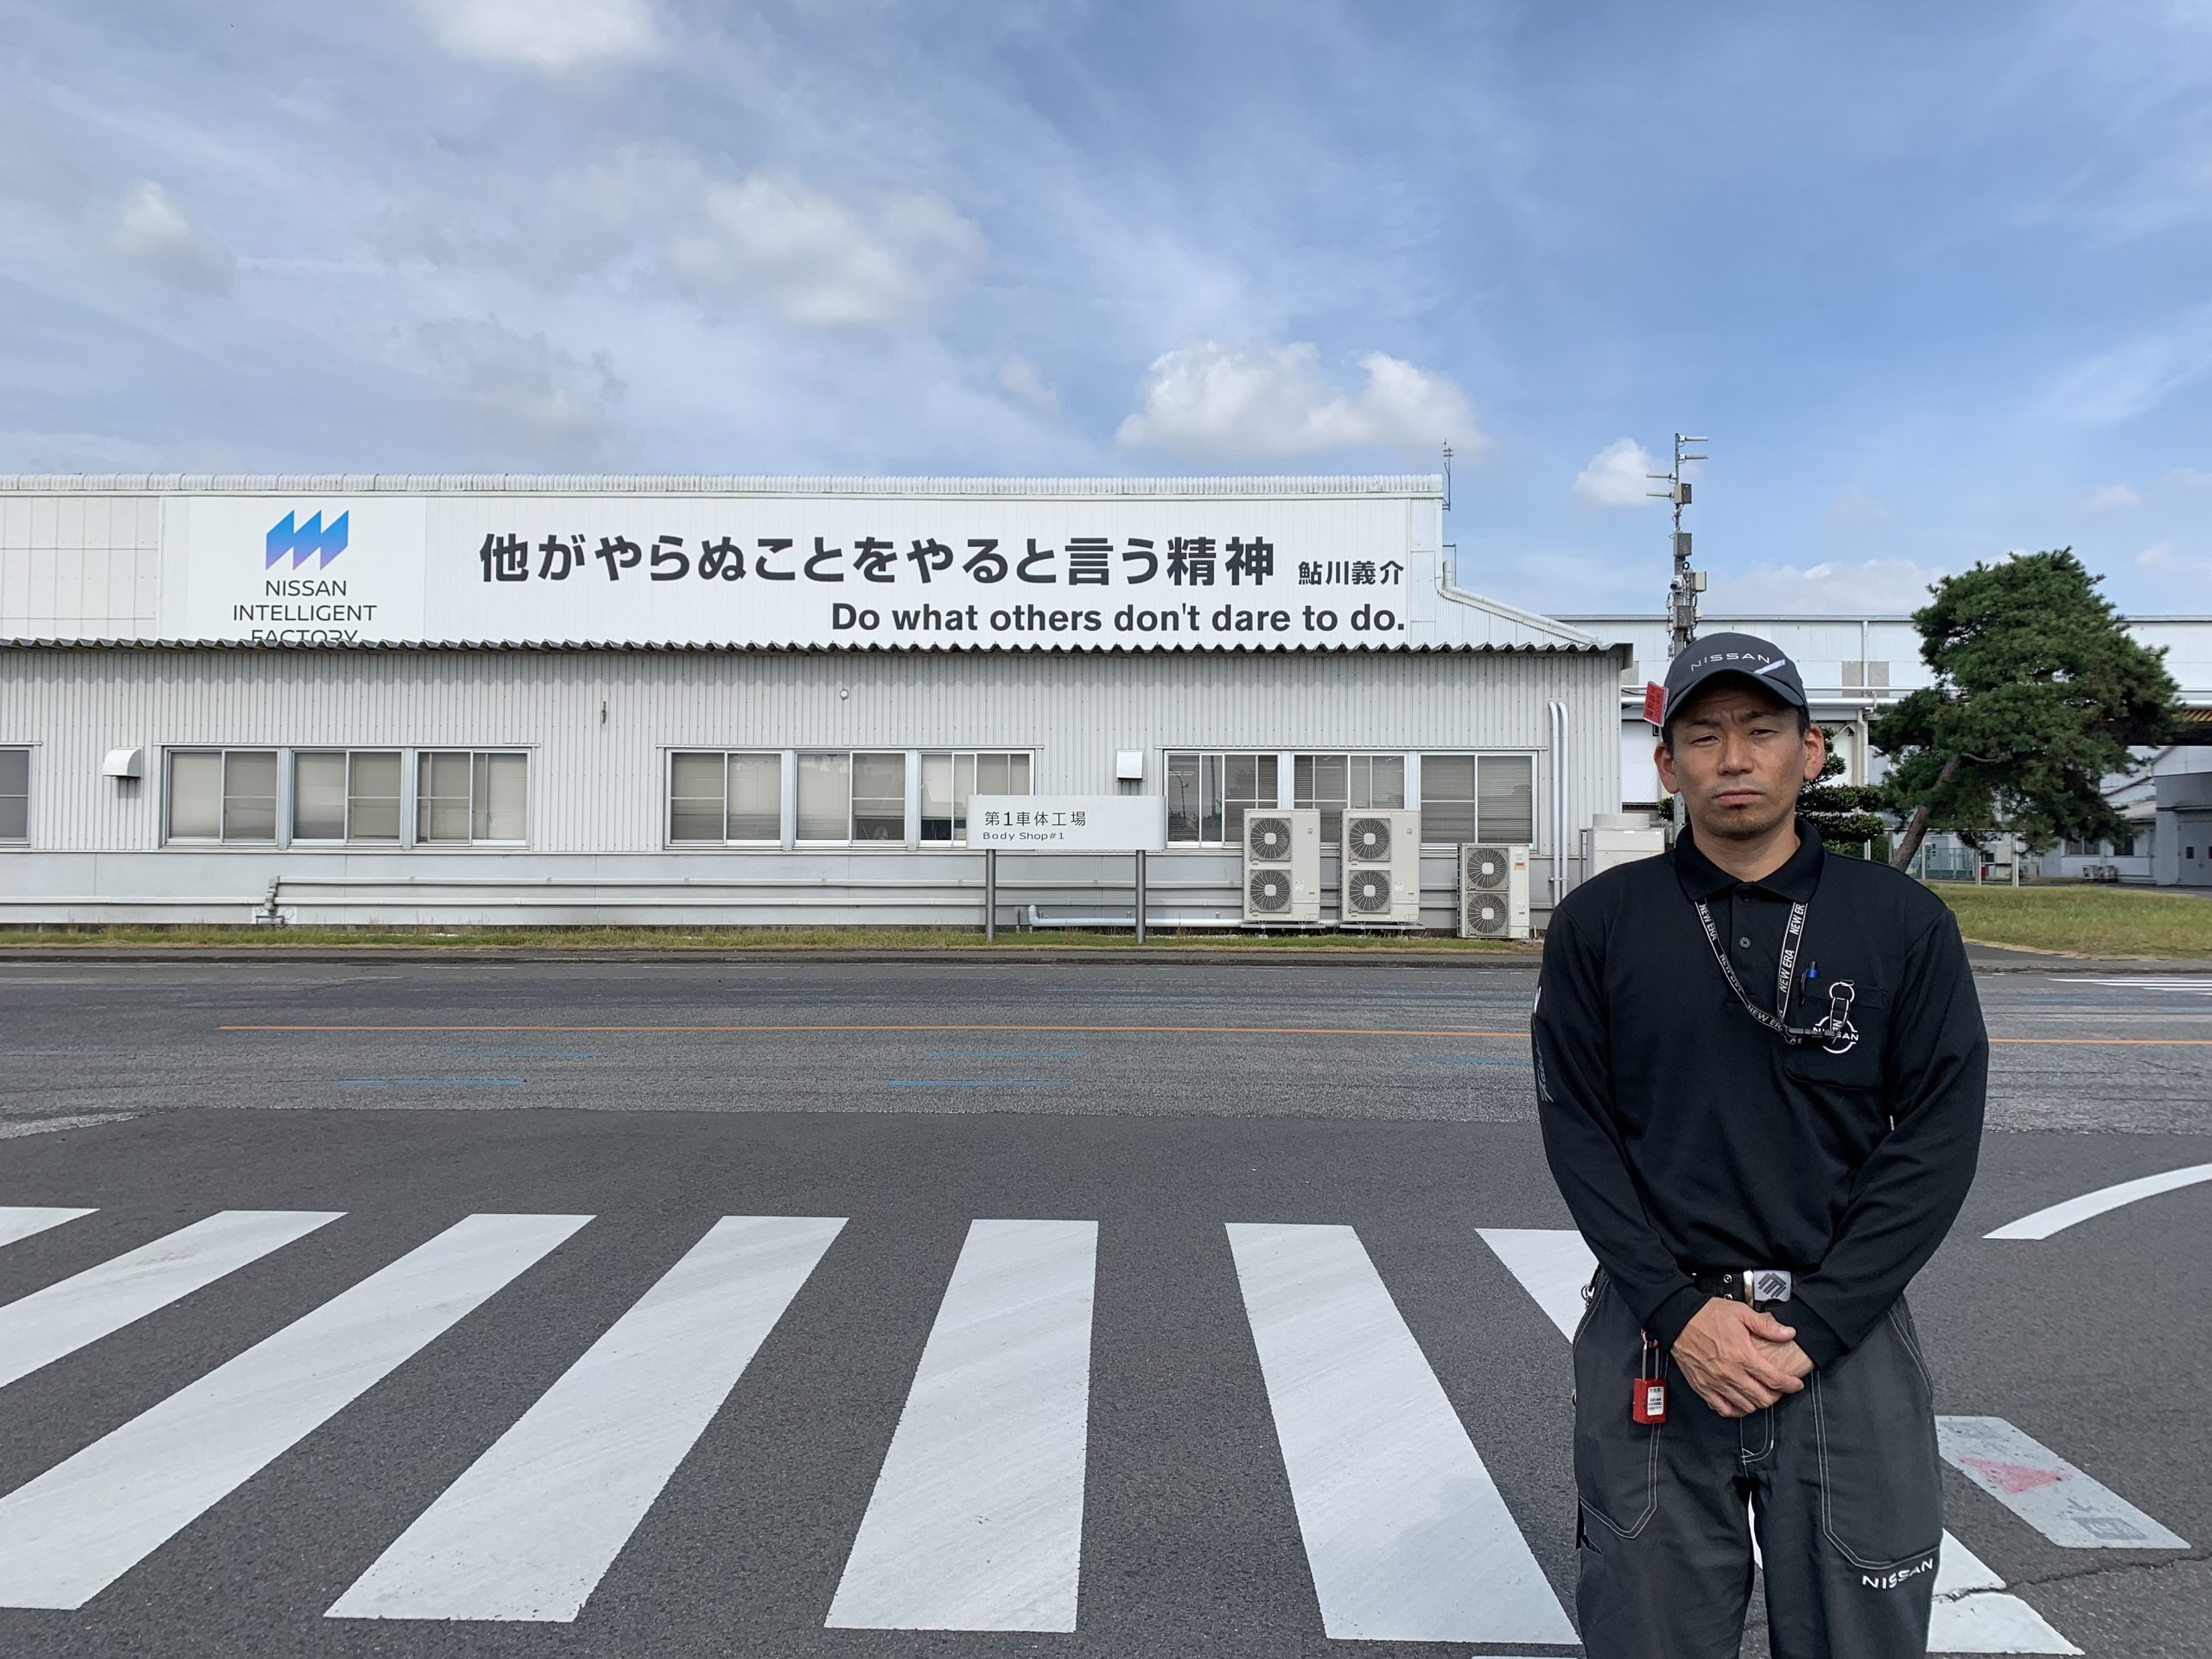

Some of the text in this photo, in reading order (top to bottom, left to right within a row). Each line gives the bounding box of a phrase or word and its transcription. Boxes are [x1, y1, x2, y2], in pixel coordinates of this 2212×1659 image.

[480, 532, 1404, 586] 他がやらぬことをやると言う精神 鮎川義介
[265, 580, 346, 596] NISSAN
[233, 605, 378, 621] INTELLIGENT
[832, 602, 1405, 632] Do what others don't dare to do.
[1690, 652, 1770, 672] NISSAN
[984, 810, 1086, 827] 第1車体工場
[982, 831, 1065, 842] Body Shop#1
[1789, 914, 1803, 935] NEW
[1779, 949, 1795, 994] NEW ERA
[1746, 1004, 1770, 1022] NEW
[1861, 1557, 1934, 1590] NISSAN
